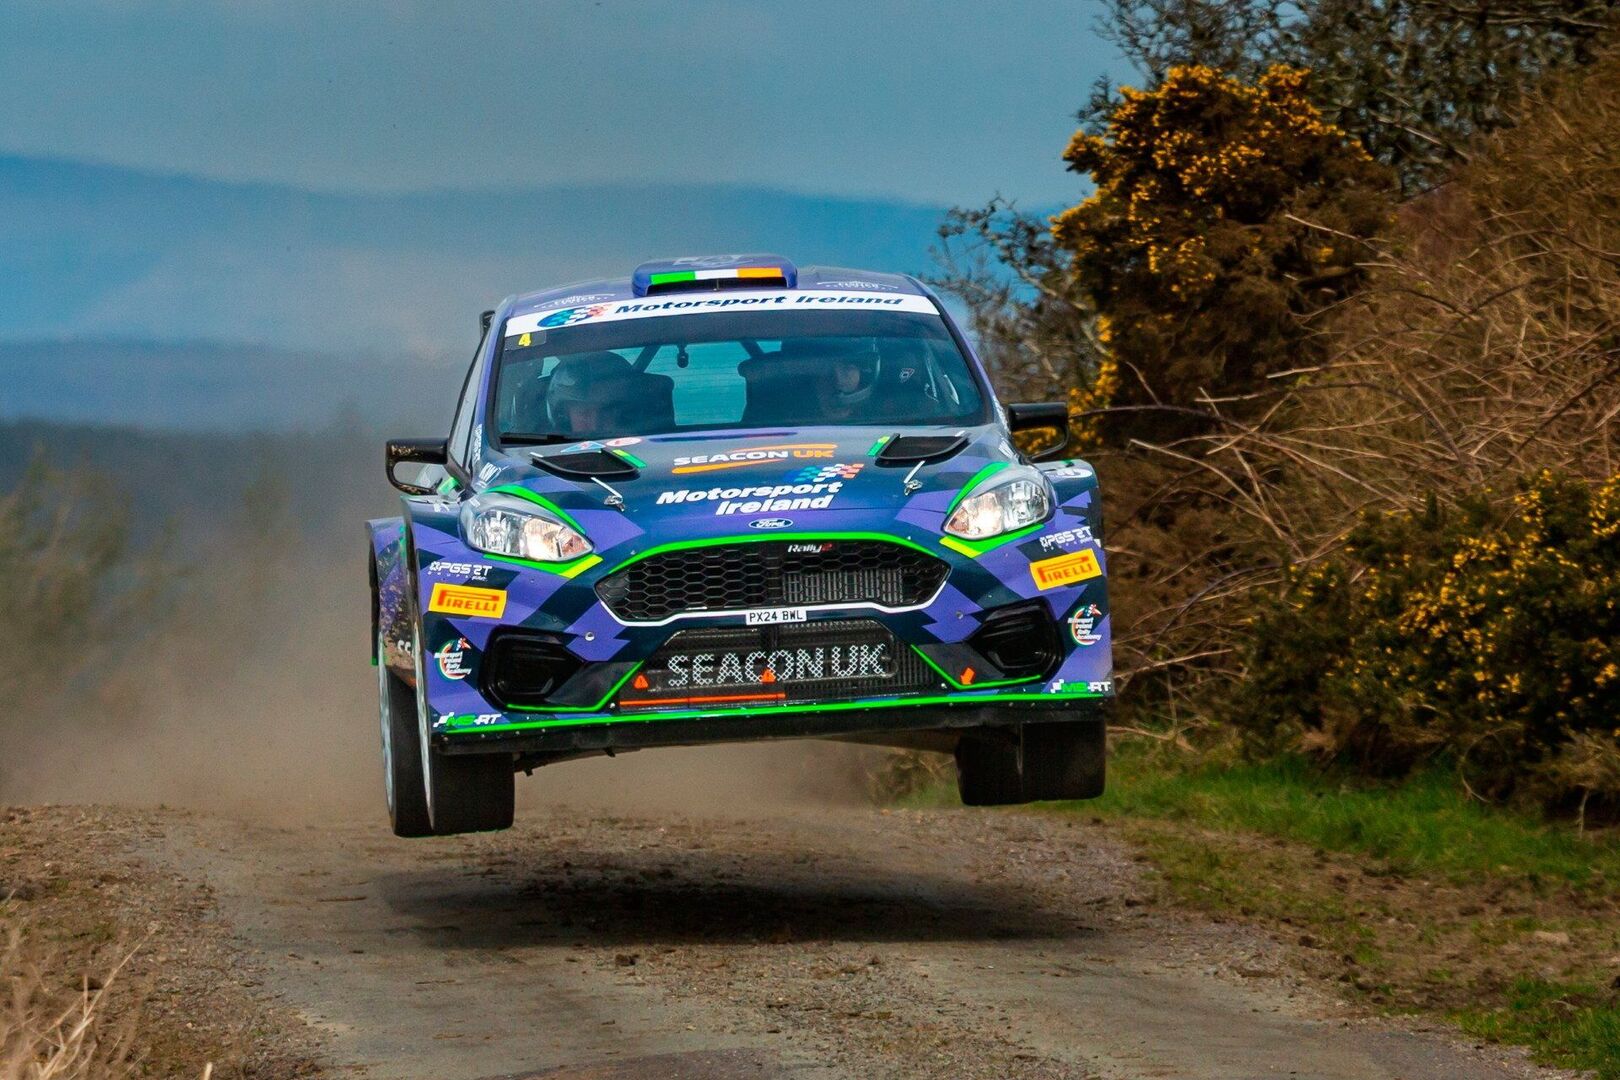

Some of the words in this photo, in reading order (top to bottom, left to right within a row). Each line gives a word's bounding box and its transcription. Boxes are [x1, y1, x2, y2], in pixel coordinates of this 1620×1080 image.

[614, 296, 788, 314] Motorsport
[795, 295, 905, 305] Ireland
[518, 332, 532, 347] 4
[673, 450, 789, 466] SEACON
[793, 449, 835, 459] UK
[656, 480, 844, 505] Motorsport
[715, 494, 836, 516] Ireland
[787, 543, 833, 553] Rally2
[1036, 556, 1093, 584] PIRELLI
[437, 590, 500, 612] PIRELLI
[749, 611, 778, 622] PX24
[782, 610, 803, 620] BWL
[668, 648, 824, 688] SEACON
[832, 643, 886, 679] UK
